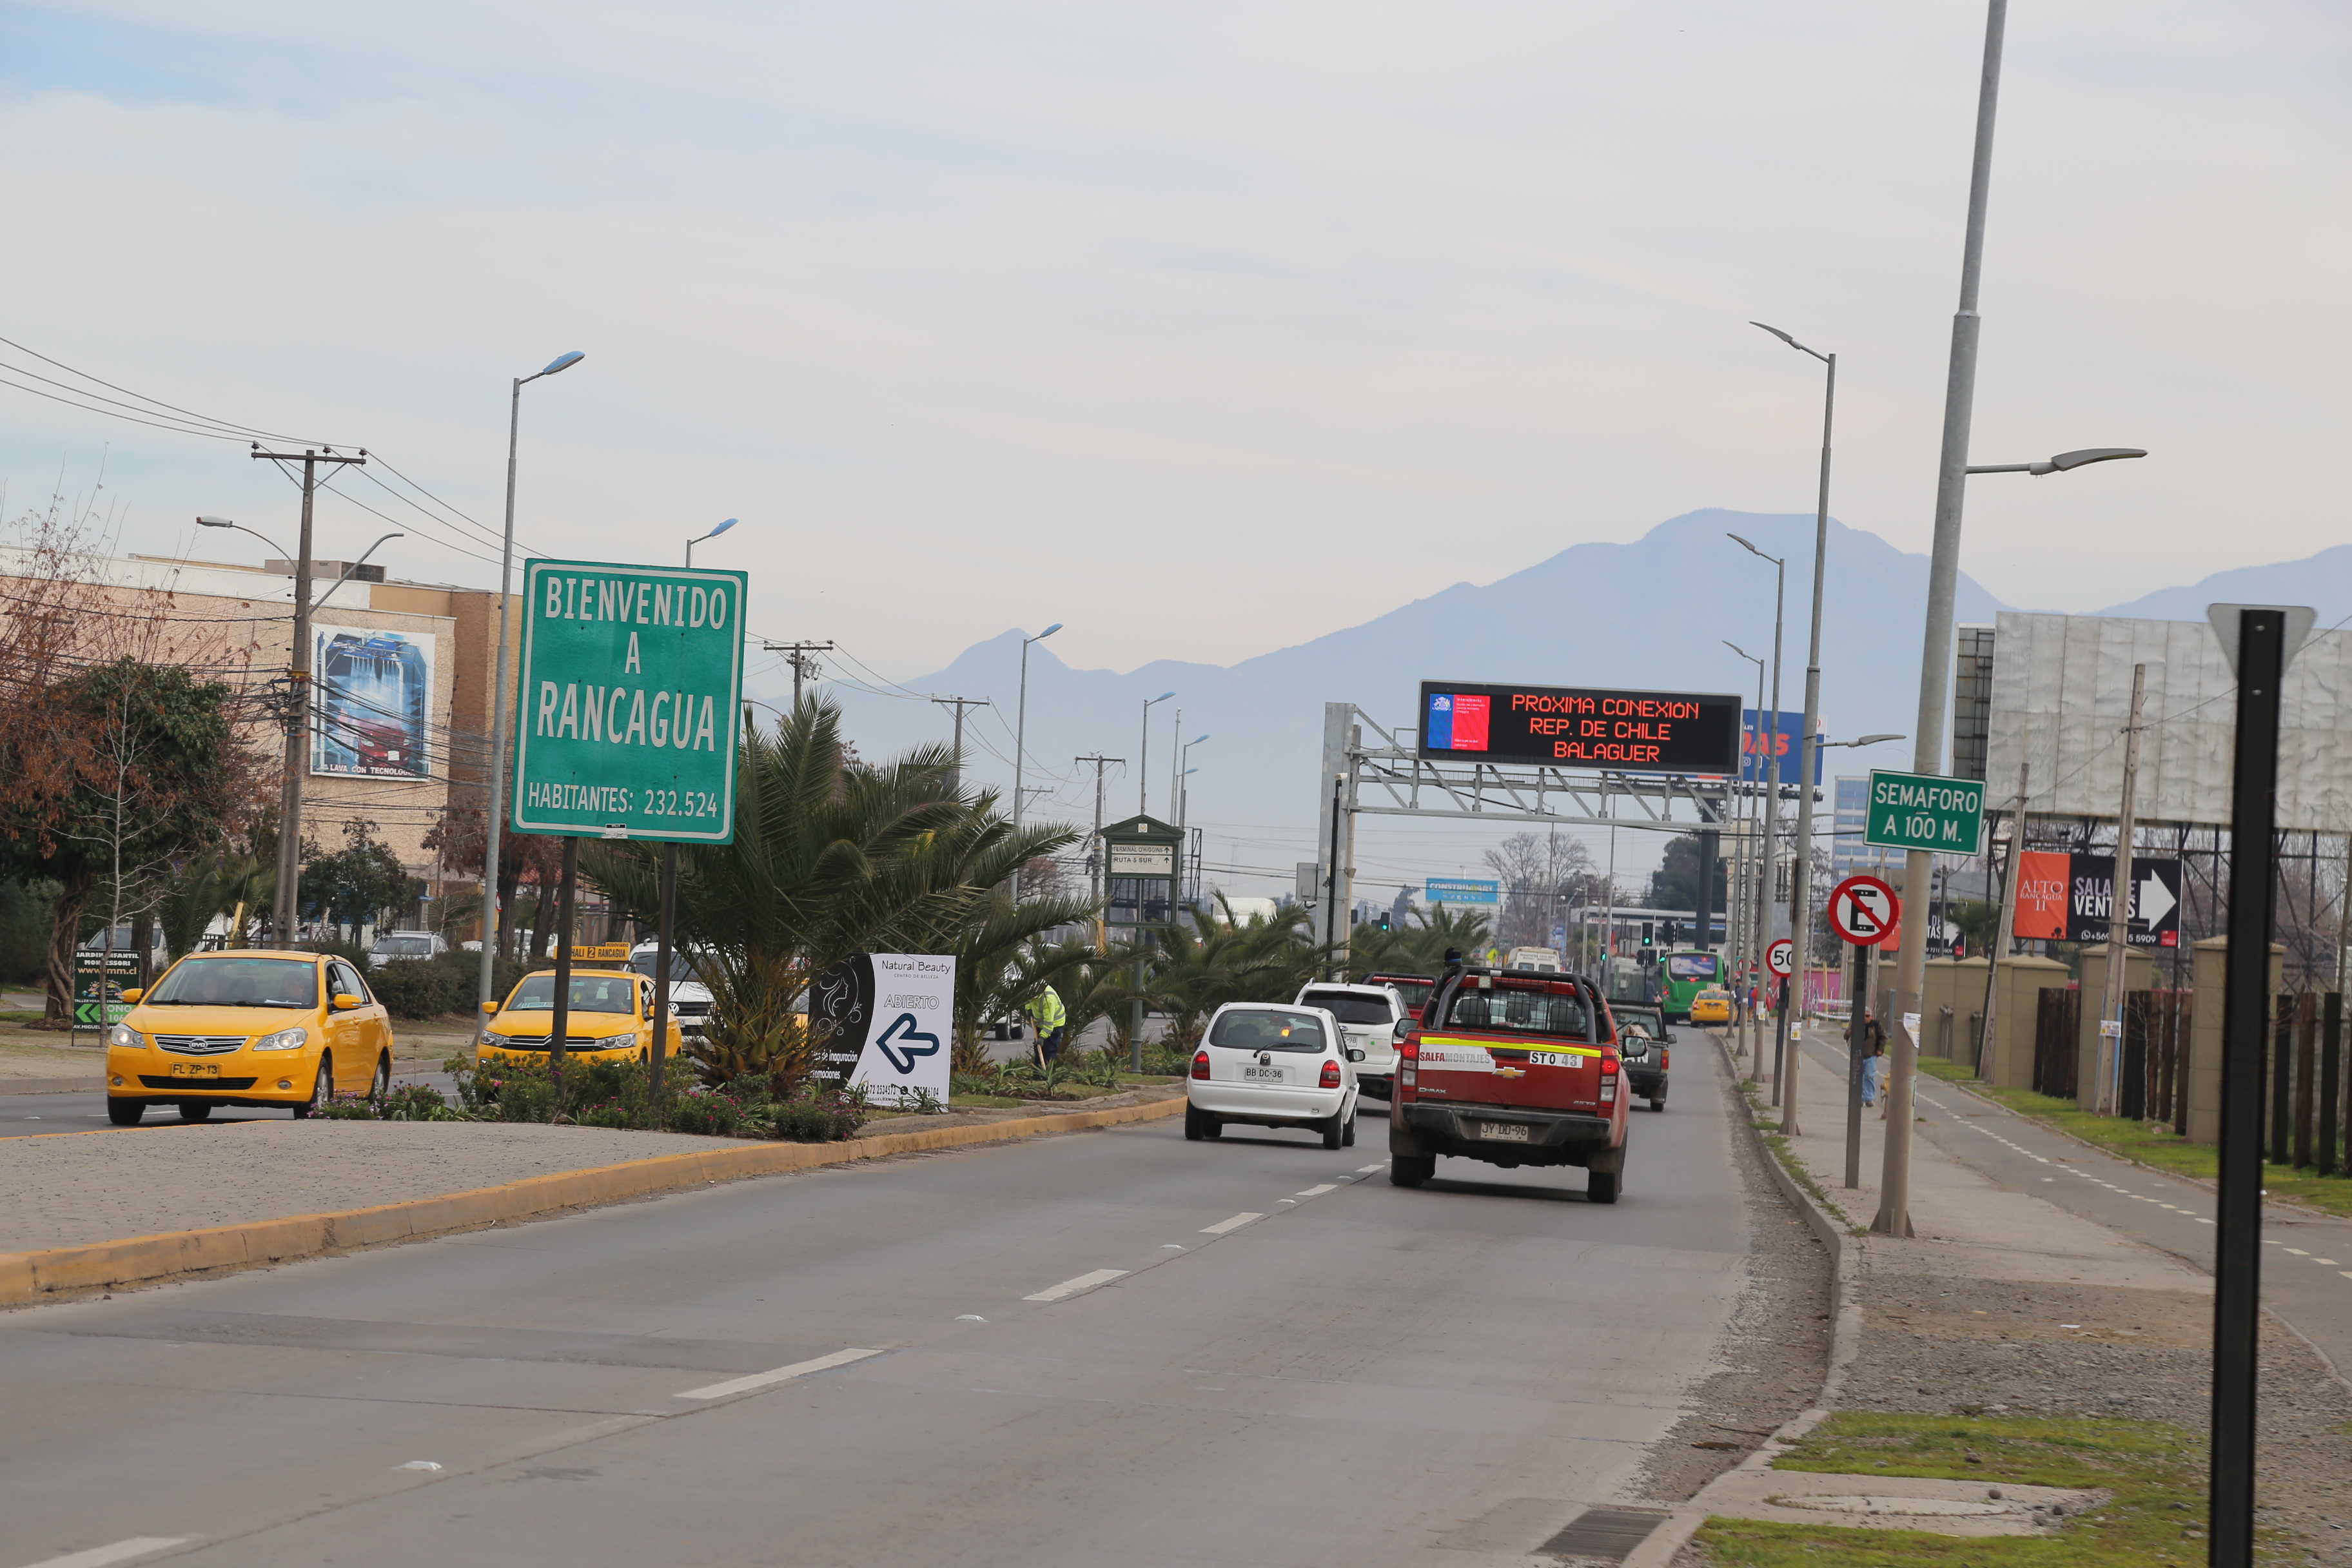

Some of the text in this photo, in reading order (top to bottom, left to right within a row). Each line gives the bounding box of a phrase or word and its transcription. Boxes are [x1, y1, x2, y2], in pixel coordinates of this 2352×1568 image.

[545, 577, 726, 629] BIENVENIDO
[625, 631, 641, 674] A
[536, 681, 714, 752] RANCAGUA
[1530, 718, 1671, 740] REP. DE CHILE
[1554, 741, 1660, 762] BALAGUER
[528, 782, 717, 818] HABITANTES: 232.524
[1875, 782, 1978, 814] SEMAFORO
[1883, 814, 1962, 842] A 100 M.
[2021, 880, 2063, 894] ALTO
[2075, 877, 2112, 896] SALA
[2020, 892, 2063, 901] RANCAGUA
[2075, 895, 2136, 918] VENTS
[2135, 934, 2156, 943] 5909
[588, 948, 595, 957] 2
[598, 949, 625, 957] RANCAGUA
[882, 960, 951, 975] Natural Beauty
[883, 994, 939, 1010] ABIERTO
[1420, 1052, 1491, 1064] SALFAMONTAJES
[1561, 1055, 1578, 1066] 43
[870, 1084, 875, 1094] 72
